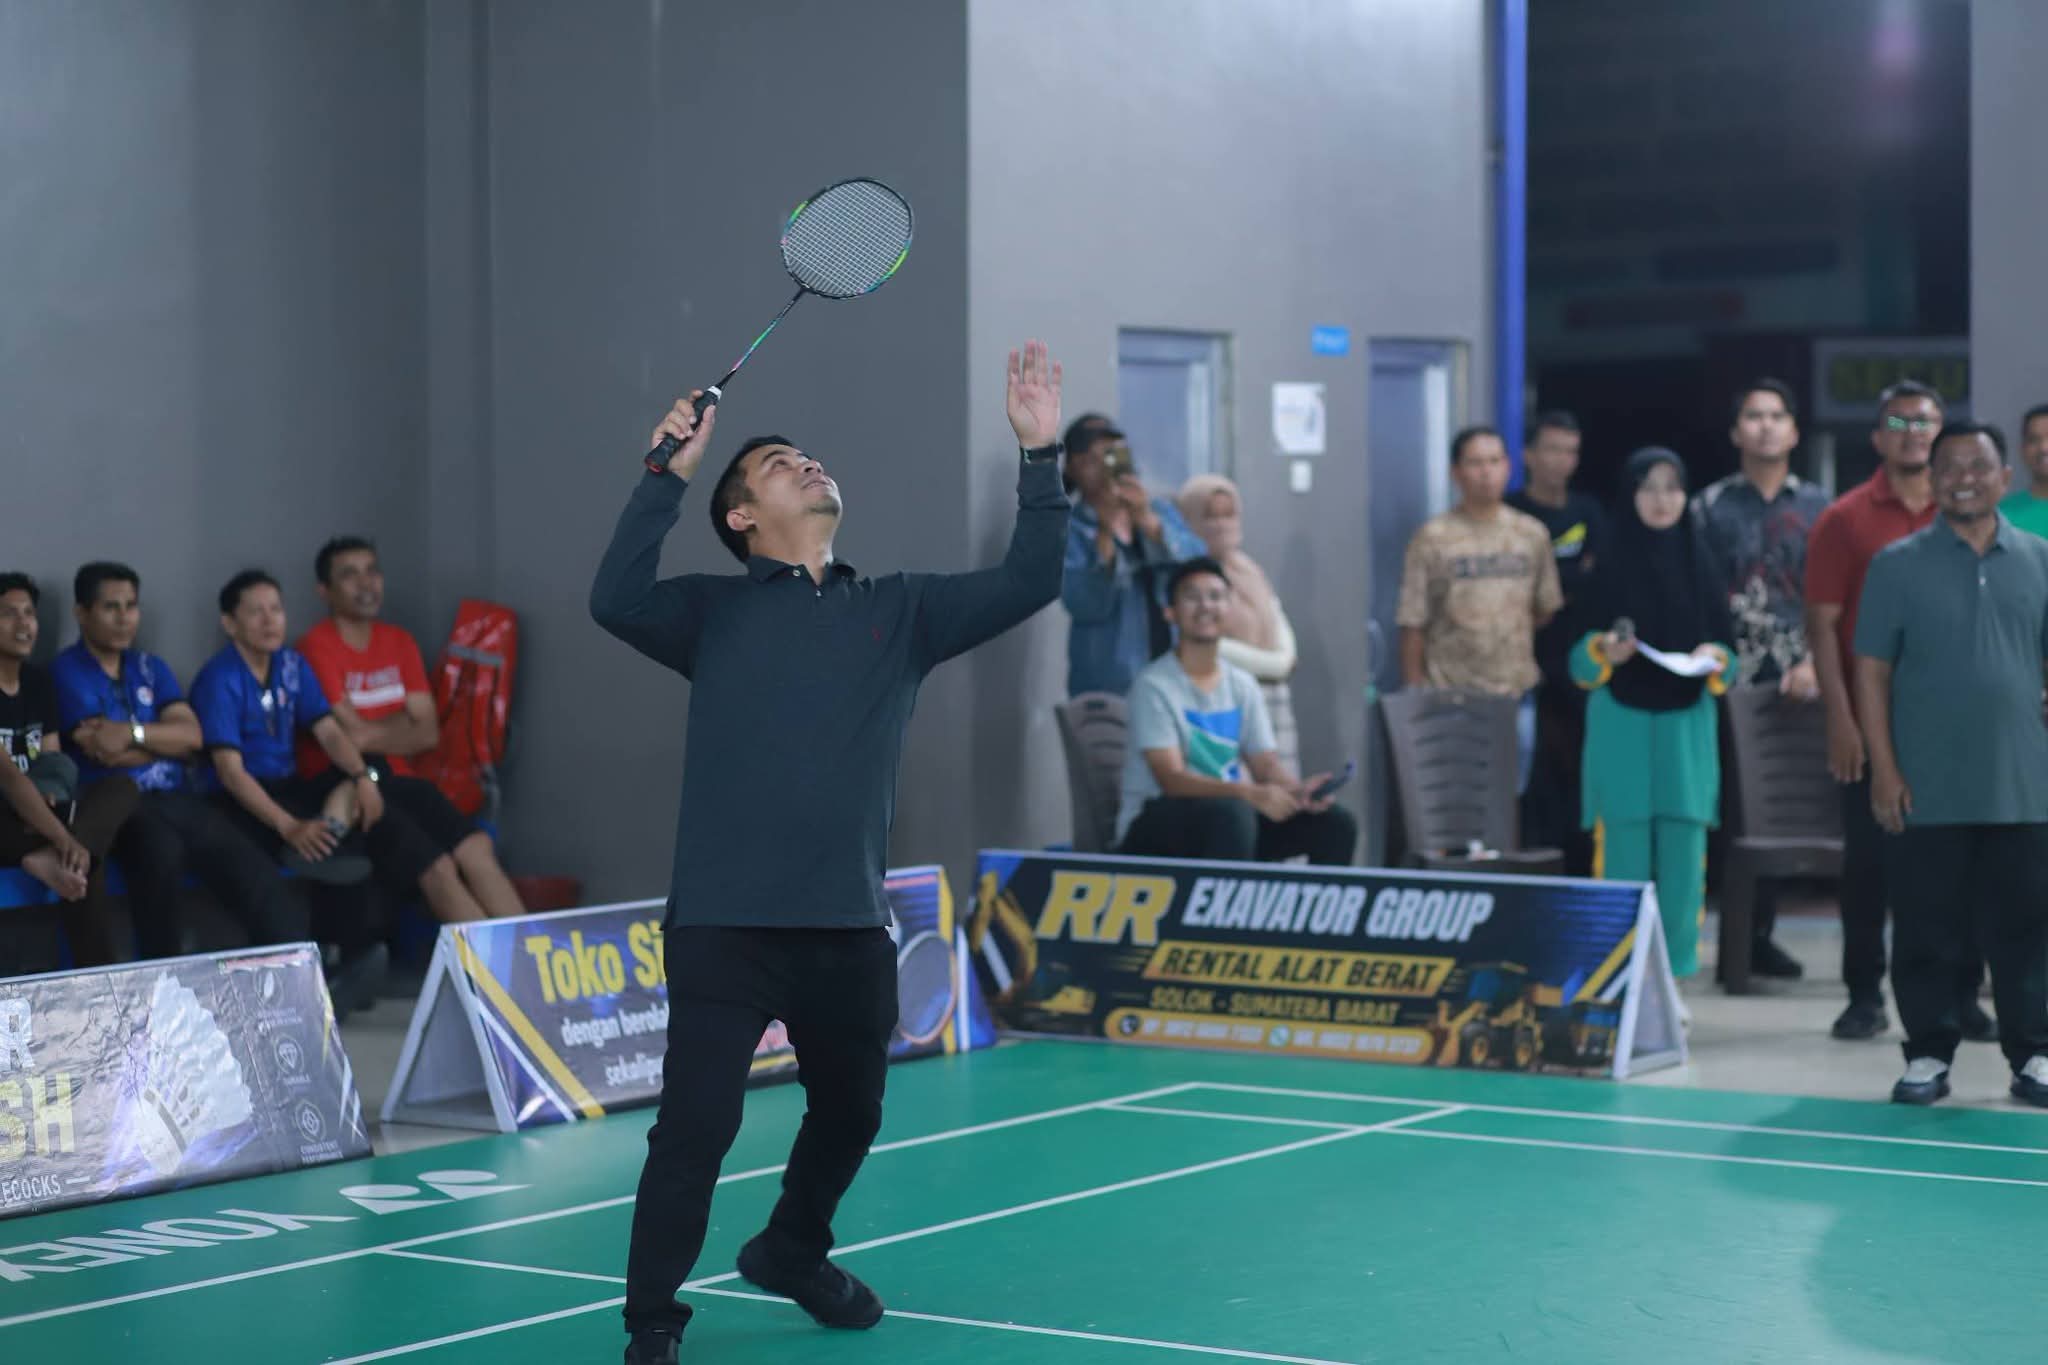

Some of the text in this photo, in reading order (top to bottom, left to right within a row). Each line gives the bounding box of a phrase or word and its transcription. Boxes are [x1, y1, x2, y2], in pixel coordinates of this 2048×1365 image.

[1034, 870, 1494, 946] RR EXAVATOR GROUP
[525, 930, 626, 1004] Toko
[1161, 947, 1438, 990] RENTAL ALAT BERAT
[1334, 1000, 1401, 1025] BARAT
[561, 1016, 621, 1048] dengan
[0, 1173, 61, 1204] ECOCKS
